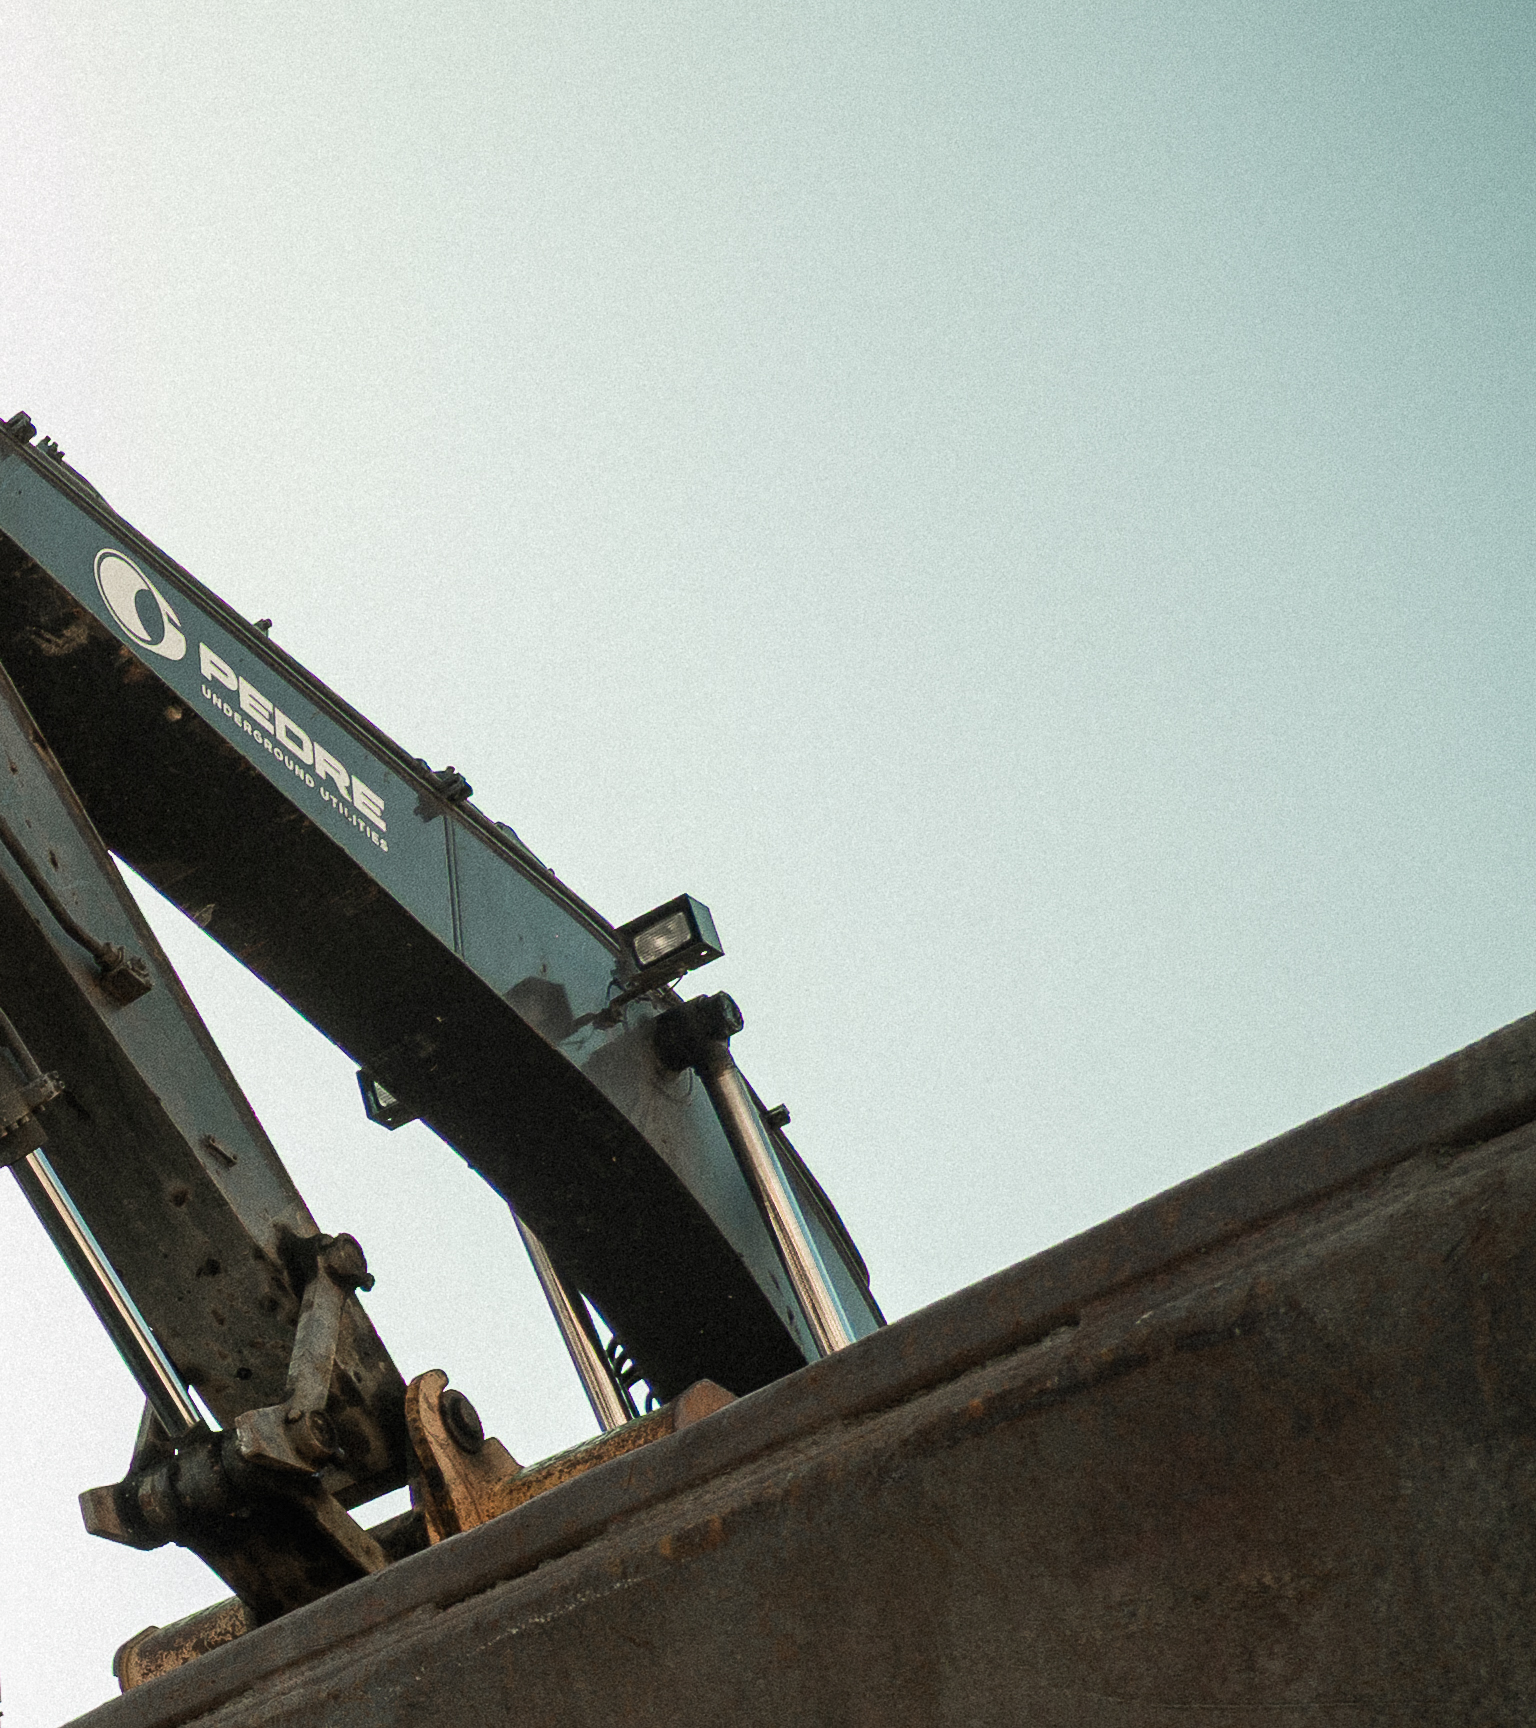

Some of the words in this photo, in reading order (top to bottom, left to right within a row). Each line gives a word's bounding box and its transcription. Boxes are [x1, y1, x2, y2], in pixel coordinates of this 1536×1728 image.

[199, 642, 387, 833] PEDRE
[201, 684, 315, 788] UNDERGROUND
[319, 786, 389, 853] UTILITIES
